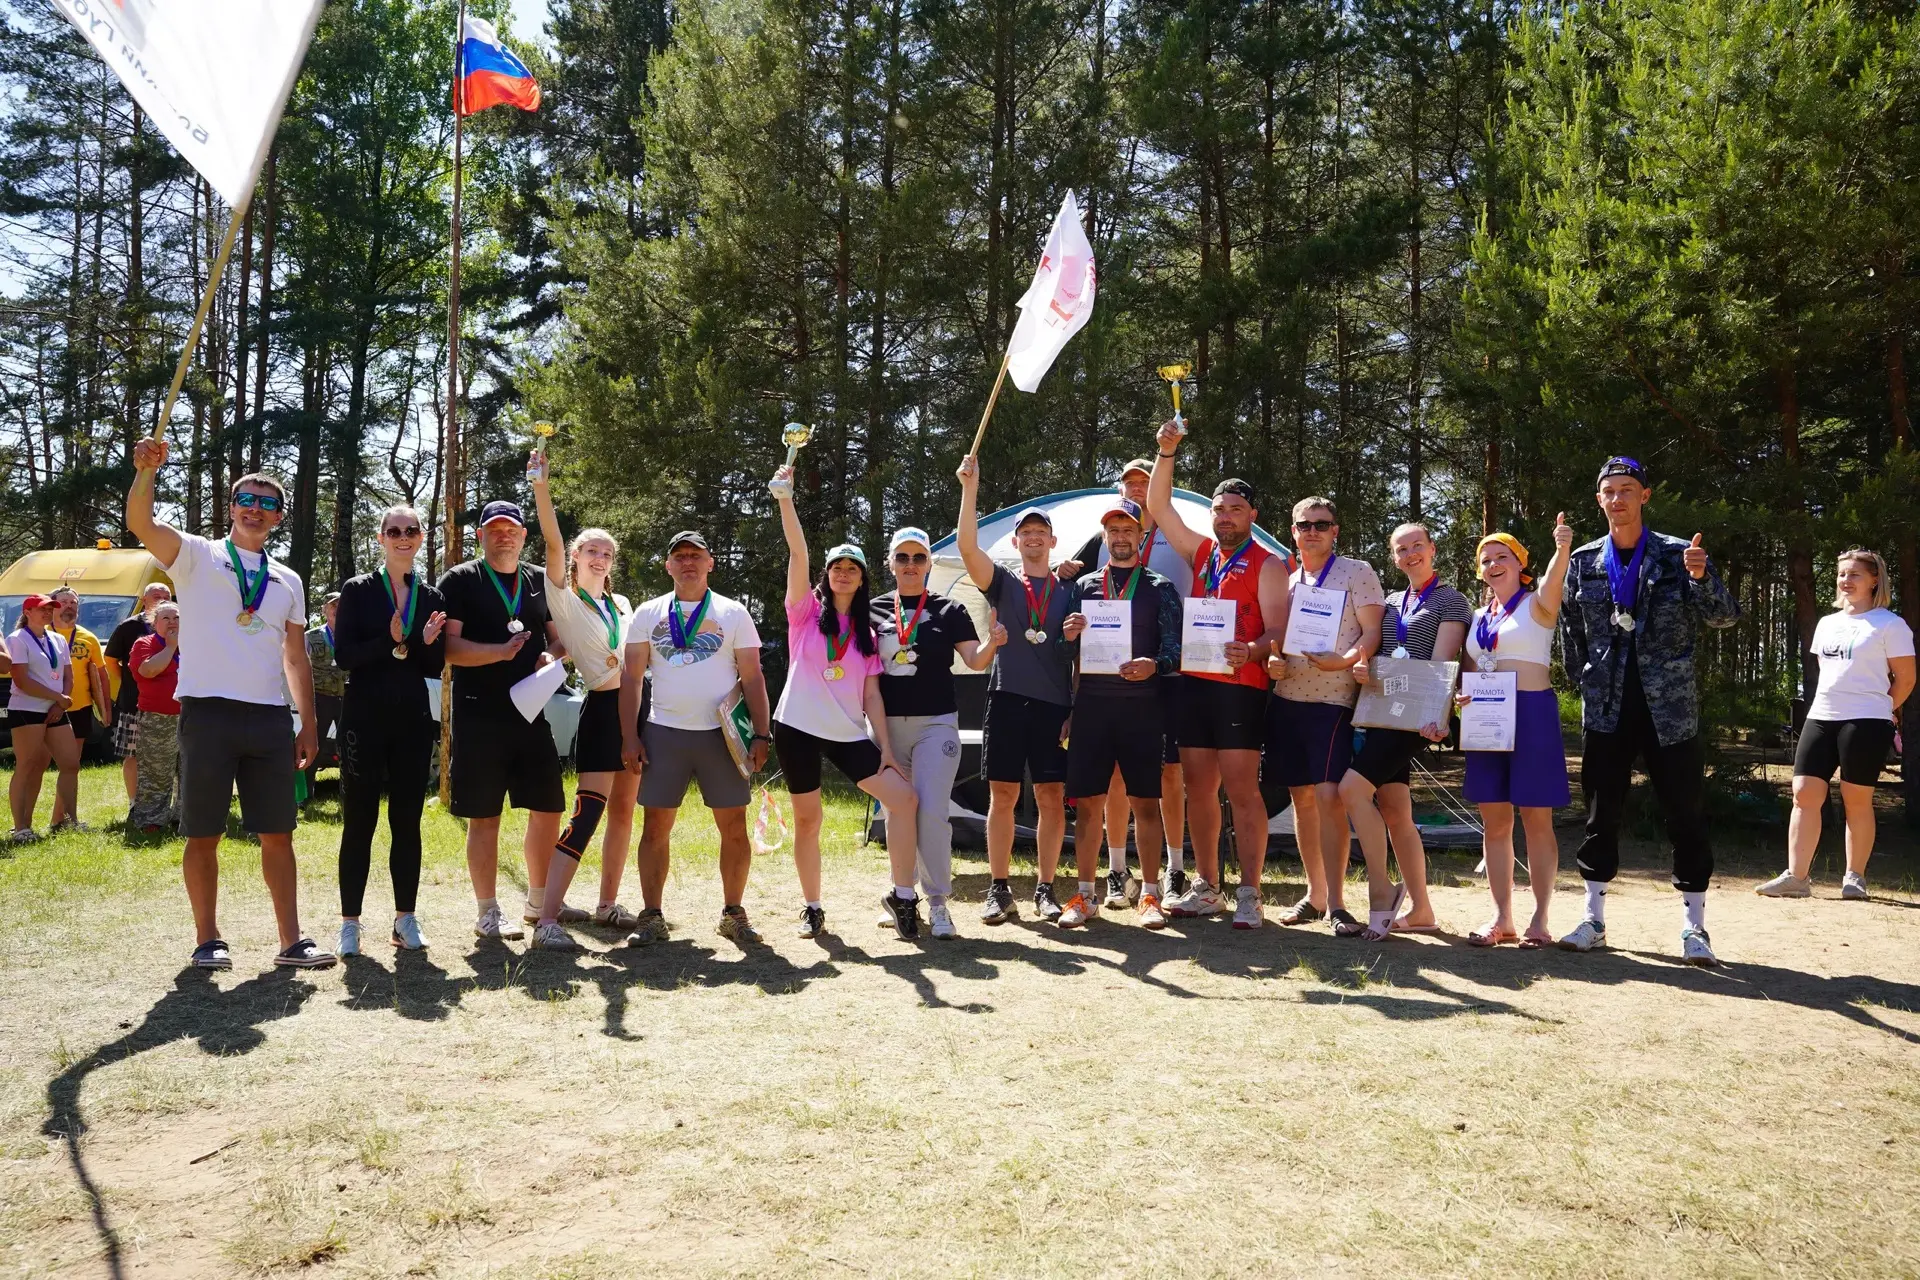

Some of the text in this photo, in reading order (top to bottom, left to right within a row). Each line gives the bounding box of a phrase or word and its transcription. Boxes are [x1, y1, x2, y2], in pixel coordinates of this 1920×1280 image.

[1301, 600, 1333, 611] ГРАМОТА
[1091, 615, 1121, 623] ГРАМОТА
[1193, 613, 1225, 622] ГРАМОТА
[1472, 688, 1505, 696] ГРАМОТА
